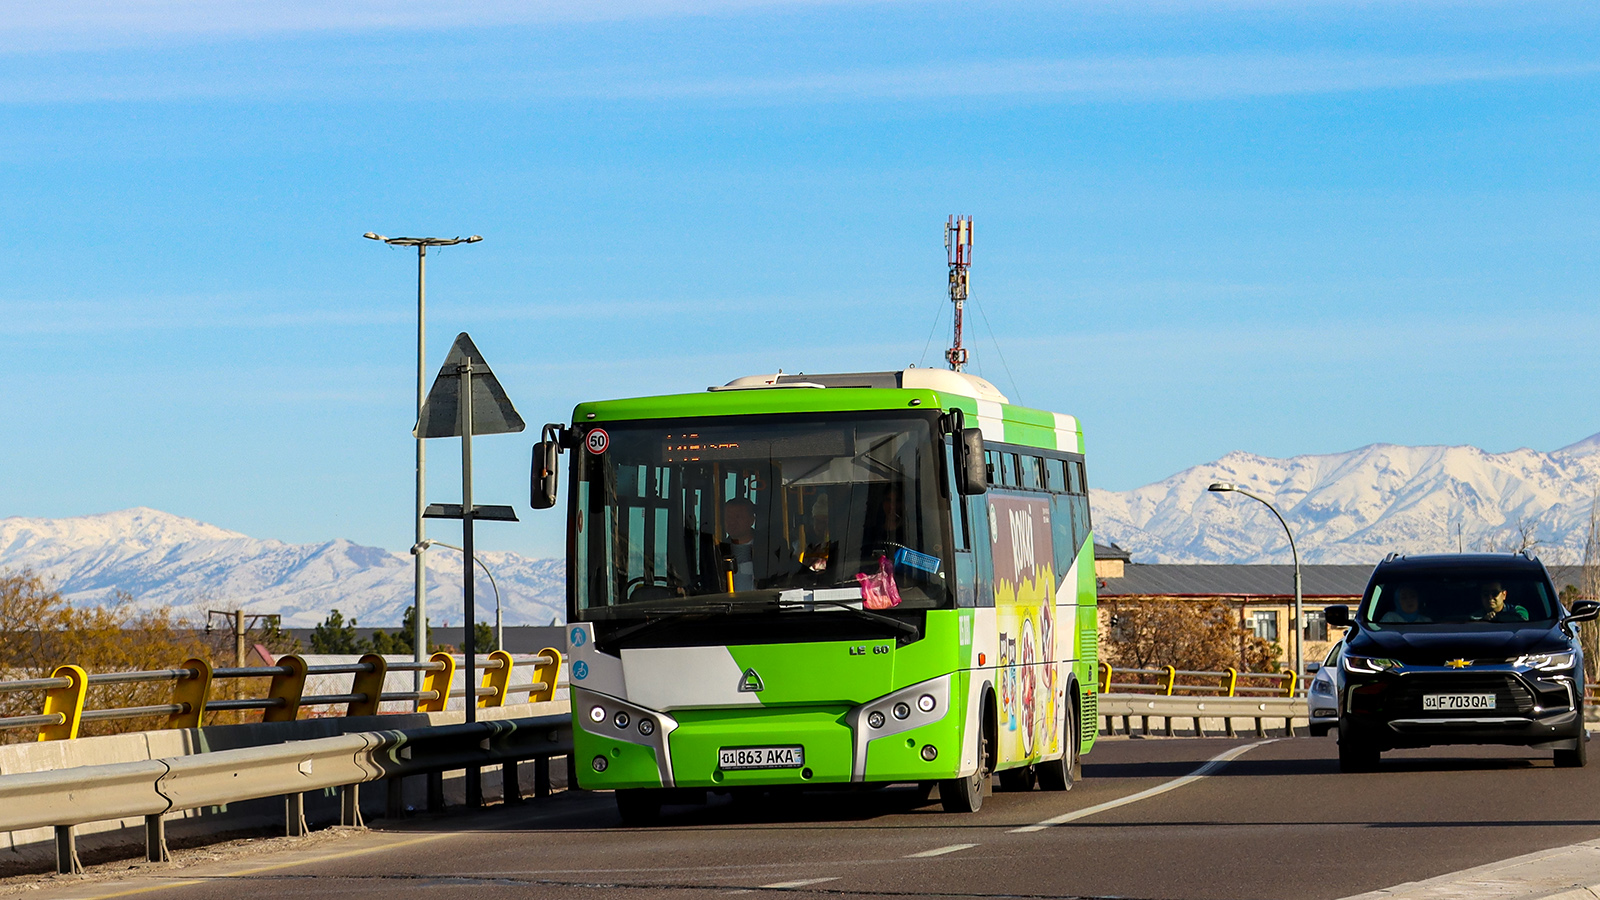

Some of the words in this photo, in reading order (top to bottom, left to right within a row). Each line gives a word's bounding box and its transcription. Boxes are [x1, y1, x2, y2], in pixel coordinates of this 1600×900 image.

[590, 435, 605, 447] 50
[849, 645, 866, 656] LE
[872, 644, 890, 655] 60
[1425, 697, 1437, 707] 01
[722, 753, 735, 764] 01
[738, 750, 762, 765] 863
[766, 749, 794, 764] AKA
